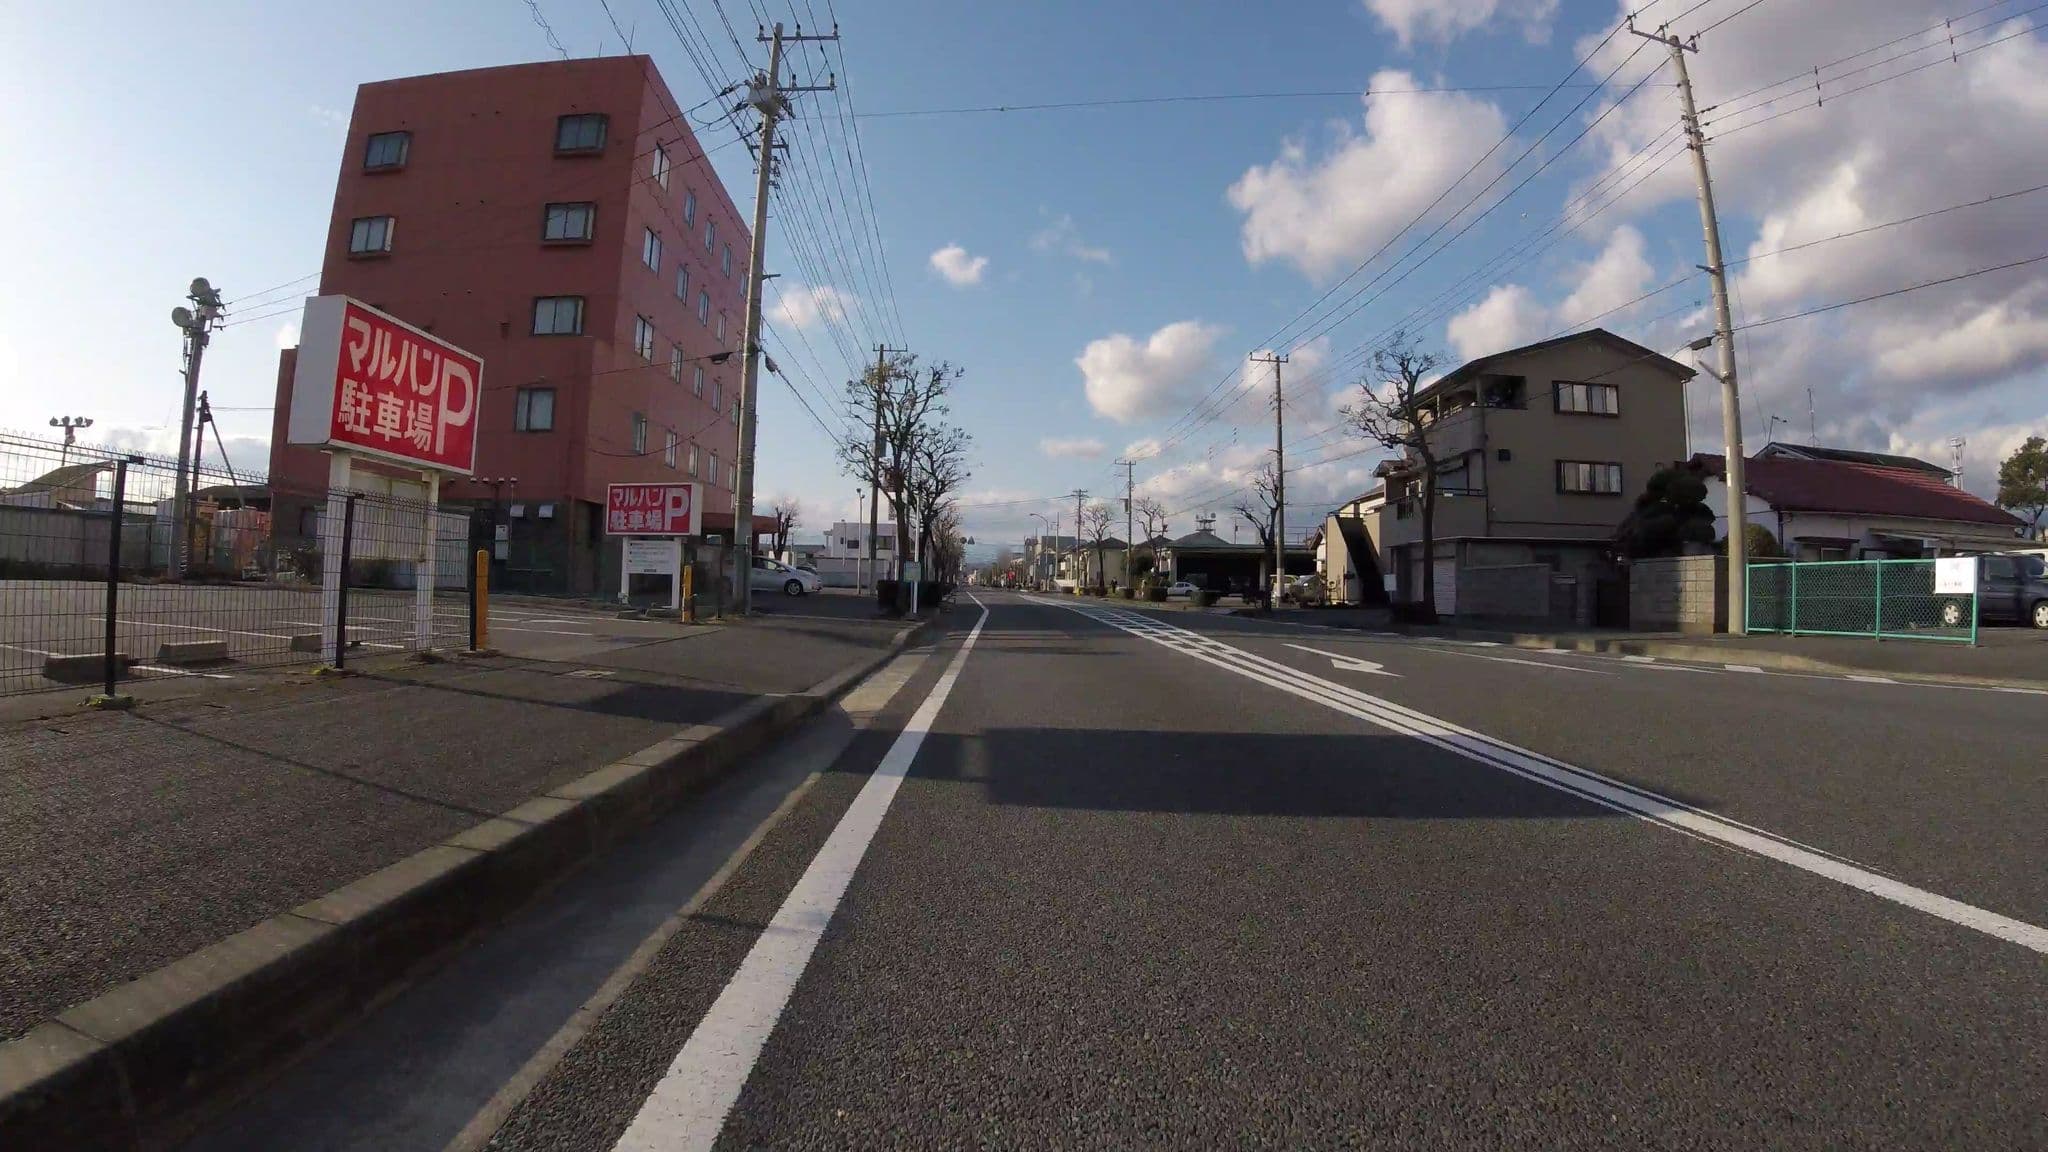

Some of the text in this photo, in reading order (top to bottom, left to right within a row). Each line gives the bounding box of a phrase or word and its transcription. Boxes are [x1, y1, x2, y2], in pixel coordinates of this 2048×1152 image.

[349, 316, 440, 396] マルハン
[338, 377, 433, 452] 駐車場
[435, 358, 474, 455] P
[611, 488, 664, 507] マルハン
[664, 487, 690, 531] P
